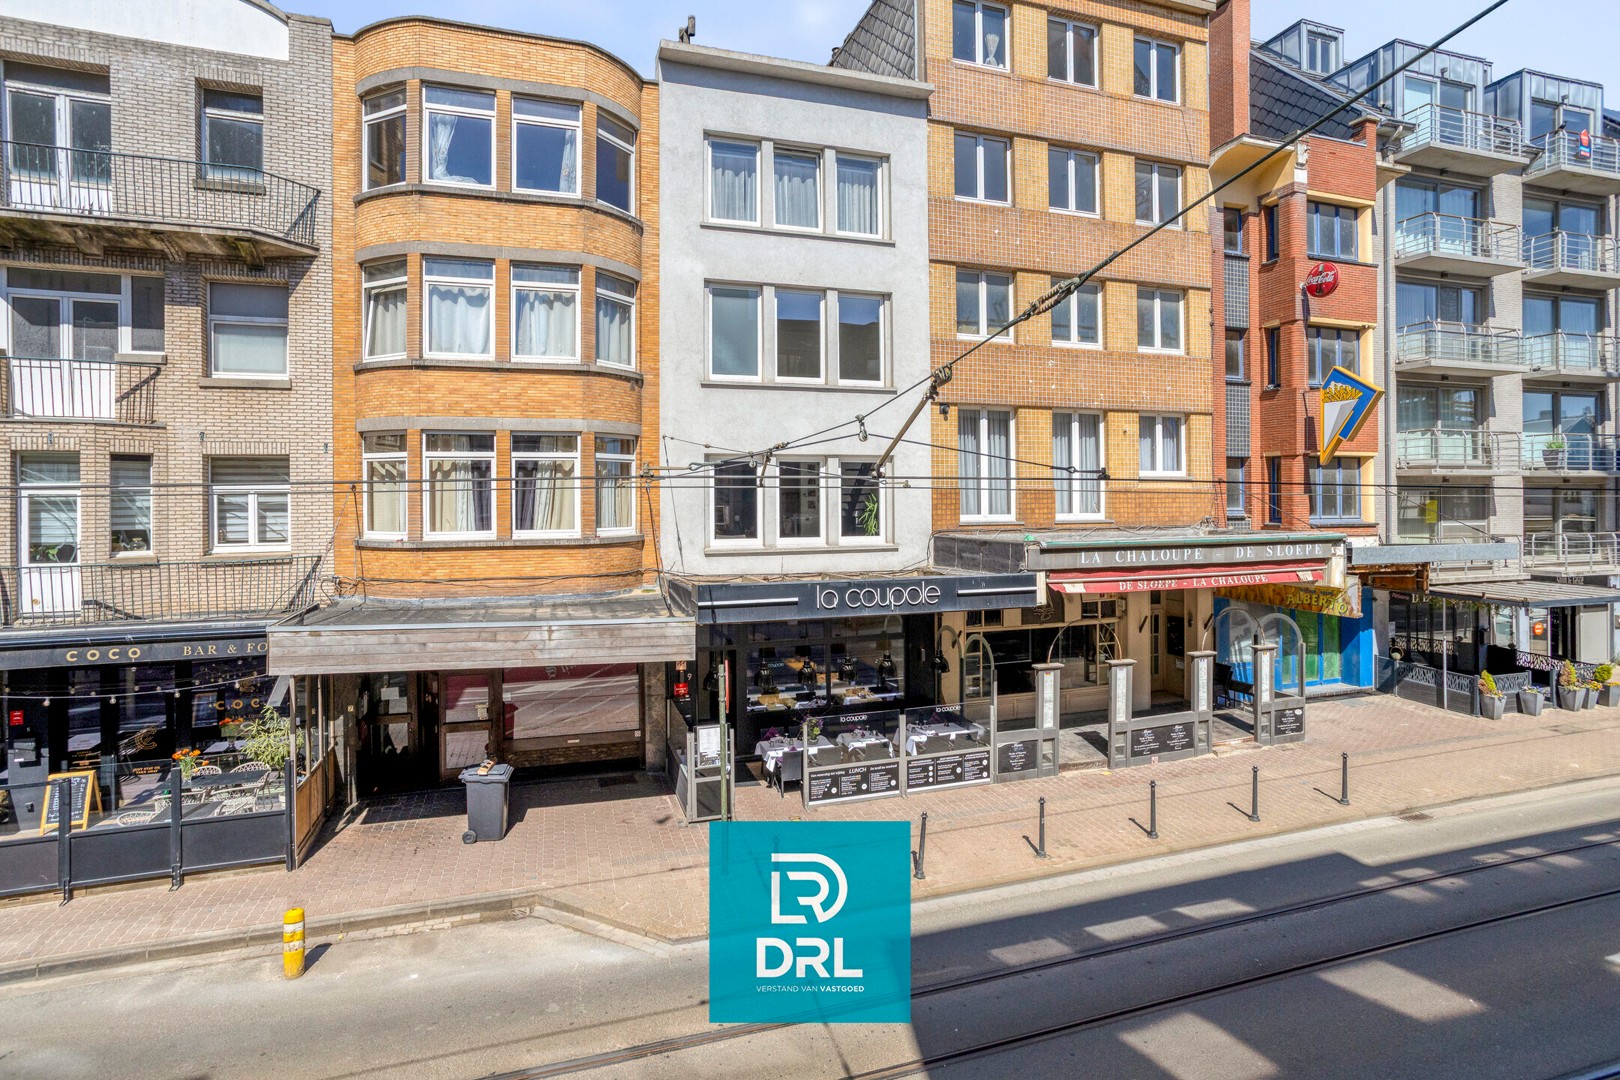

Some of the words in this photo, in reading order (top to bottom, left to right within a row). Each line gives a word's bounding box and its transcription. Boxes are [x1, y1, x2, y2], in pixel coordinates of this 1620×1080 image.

[1081, 552, 1101, 564] LA
[1115, 548, 1203, 562] CHALOUPE
[1236, 546, 1254, 558] DE
[1266, 543, 1322, 557] SLOEPE
[1119, 581, 1133, 591] DE
[1137, 579, 1178, 589] SLOEPE
[1193, 578, 1207, 587] LA
[1211, 574, 1269, 586] CHALOUPE
[816, 585, 839, 610] la
[845, 581, 941, 611] coupole
[1286, 593, 1348, 613] ALBERTO
[66, 647, 141, 662] COCO
[183, 645, 218, 656] BAR
[228, 644, 238, 654] &
